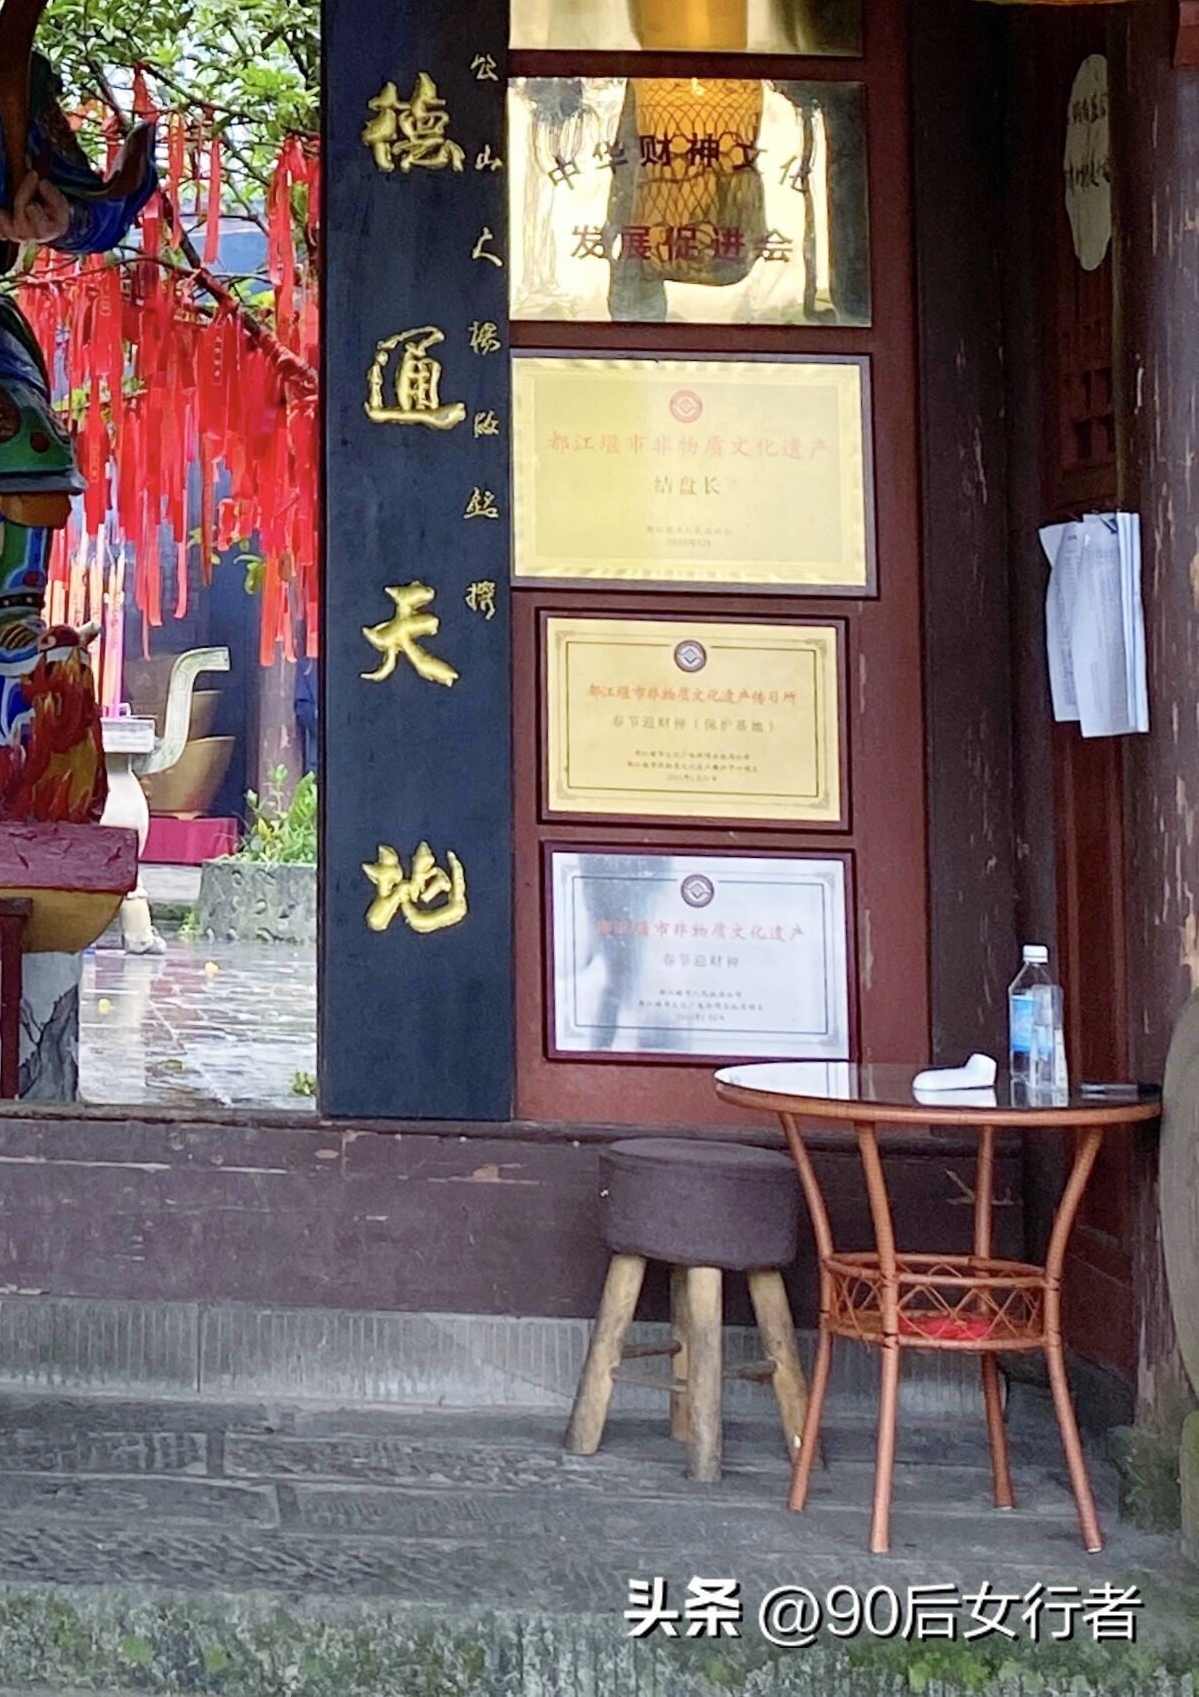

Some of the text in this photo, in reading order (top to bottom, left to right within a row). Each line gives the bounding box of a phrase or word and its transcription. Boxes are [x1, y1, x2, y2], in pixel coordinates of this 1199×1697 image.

[548, 132, 813, 193] 中华财神文化
[571, 224, 794, 263] 发展促进会
[548, 431, 828, 460] 都江堰市非物质文化遗产
